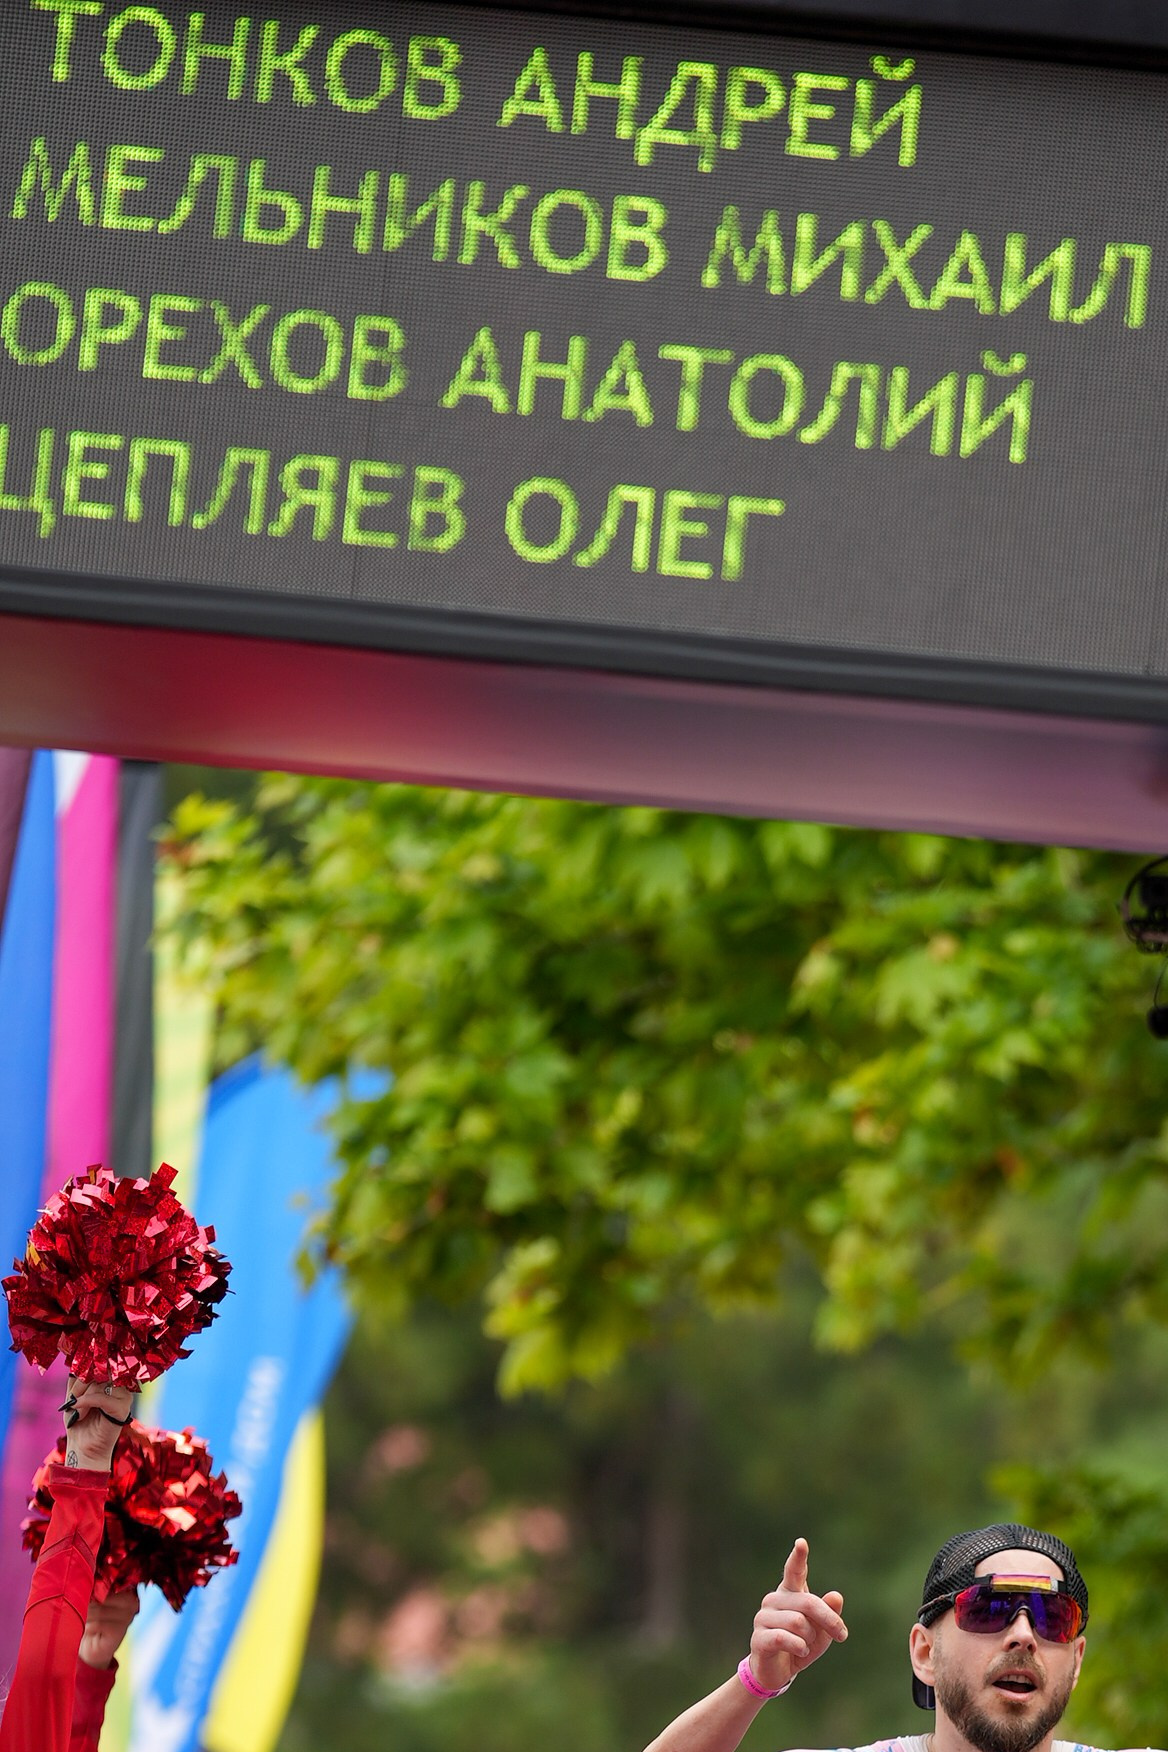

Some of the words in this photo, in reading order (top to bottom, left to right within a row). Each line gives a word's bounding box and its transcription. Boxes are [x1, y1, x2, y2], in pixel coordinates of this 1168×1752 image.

[30, 0, 463, 121] ТОНКОВ
[497, 47, 923, 172] АНДРЕЙ
[12, 138, 668, 282] МЕЛЬНИКОВ
[702, 206, 1151, 328] МИХАИЛ
[0, 282, 405, 401] ОРЕХОВ
[441, 327, 1032, 464] АНАТОЛИЙ
[0, 425, 466, 552] ЦЕПЛЯЕВ
[504, 477, 785, 580] ОЛЕГ
